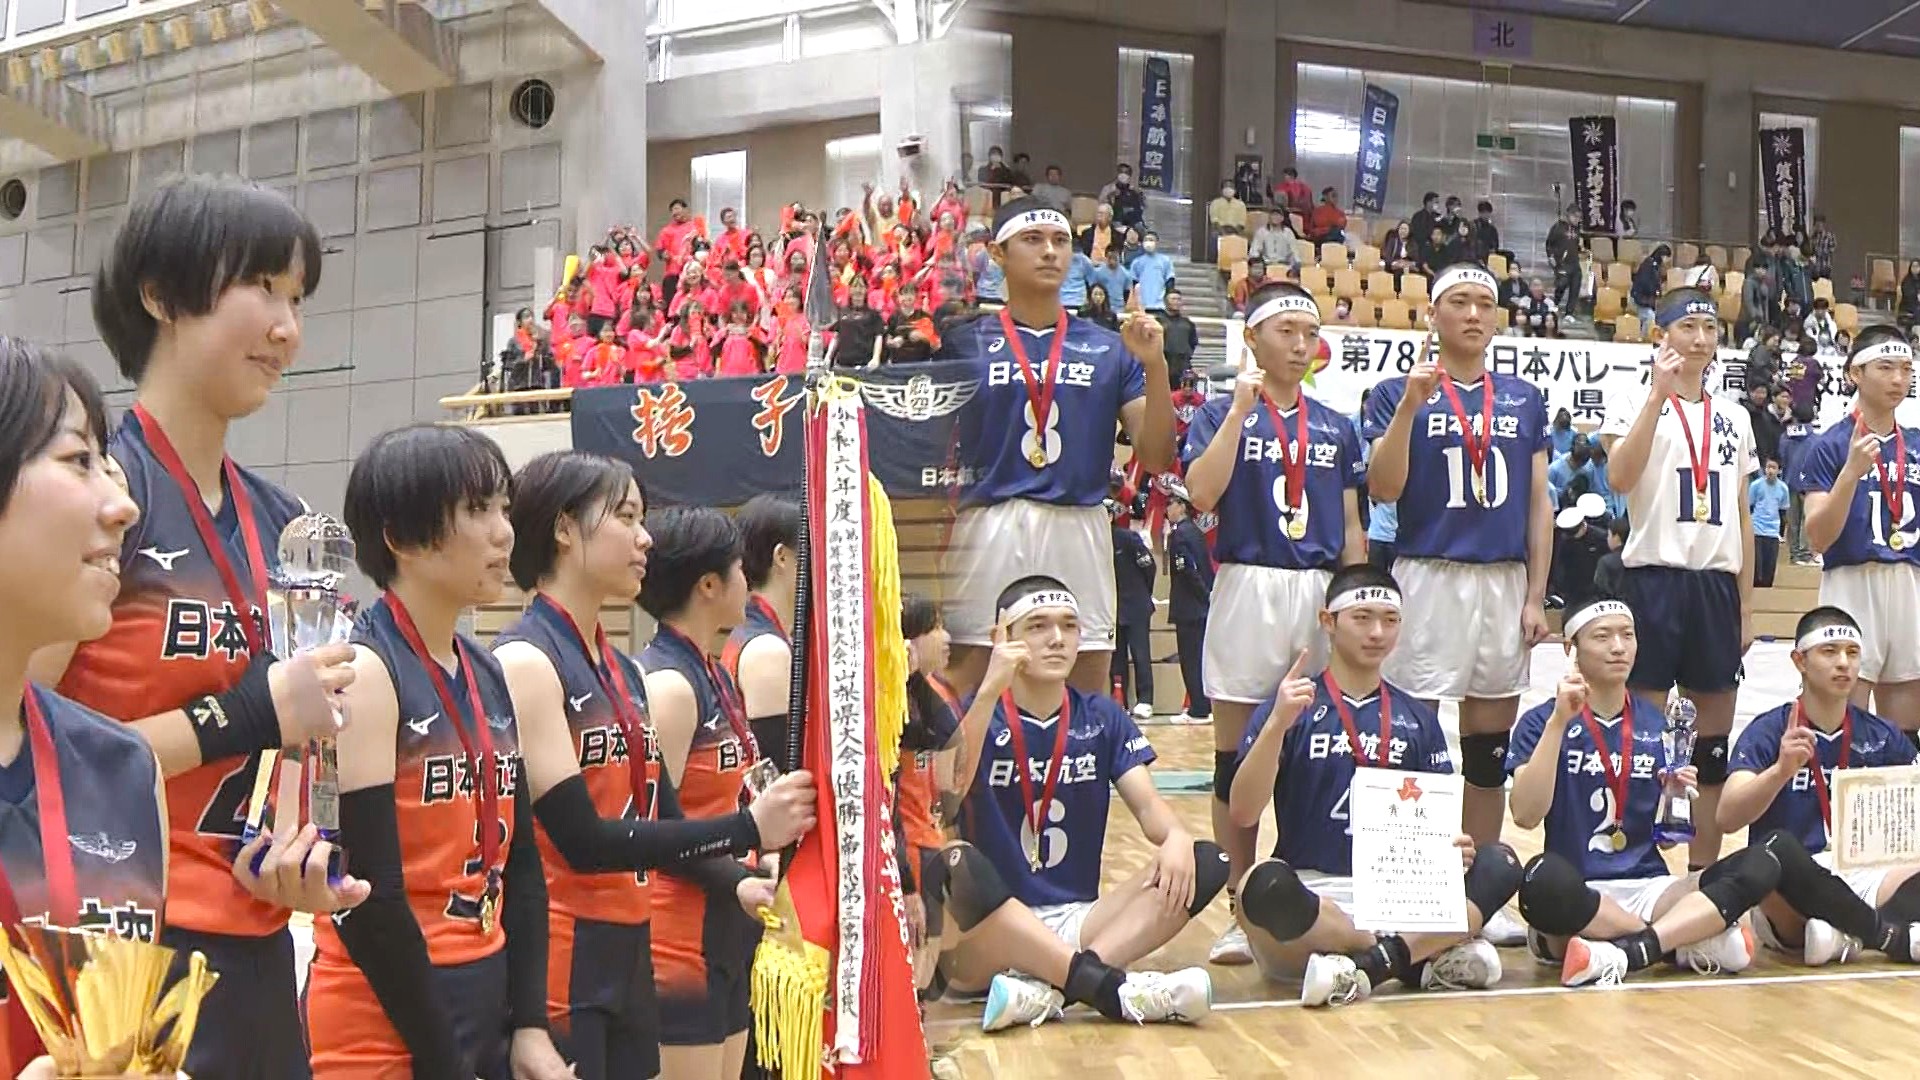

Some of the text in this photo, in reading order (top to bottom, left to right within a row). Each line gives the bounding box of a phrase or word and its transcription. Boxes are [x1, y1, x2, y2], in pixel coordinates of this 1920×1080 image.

[1490, 21, 1515, 48] 北
[1021, 400, 1062, 465] 8
[1273, 475, 1309, 539] 9
[1442, 446, 1509, 509] 10
[1676, 467, 1723, 526] 11
[1868, 490, 1920, 549] 12
[1309, 730, 1408, 765] 日本航空
[1020, 798, 1068, 868] 6
[1588, 787, 1618, 852] 2
